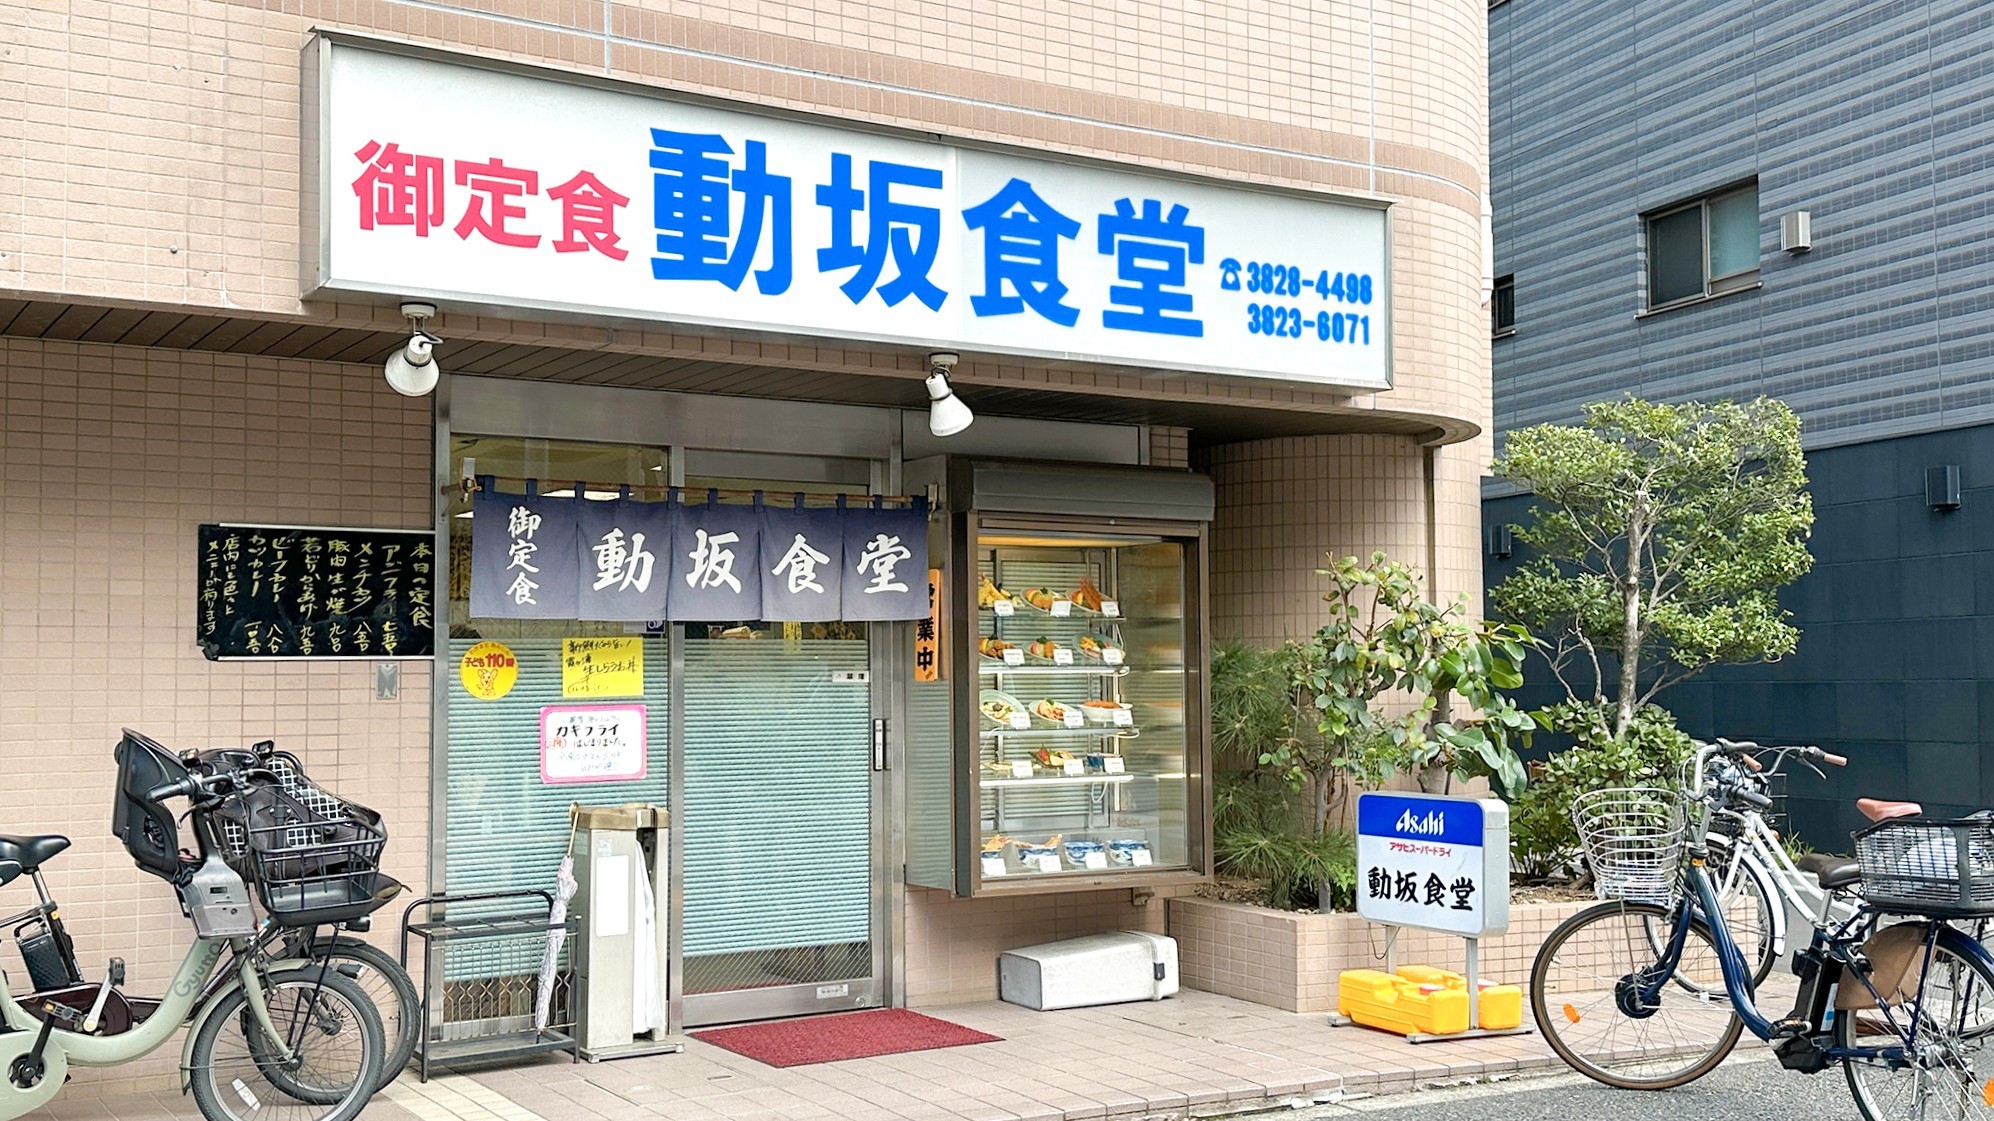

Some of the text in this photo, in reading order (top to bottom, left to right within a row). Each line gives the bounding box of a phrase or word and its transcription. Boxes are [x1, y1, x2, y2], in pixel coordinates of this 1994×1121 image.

[351, 128, 1205, 338] 御定食 動坂食堂
[1247, 261, 1373, 306] 3828-4498
[1247, 303, 1371, 346] 3823-6071
[247, 534, 267, 597] カツカレー
[268, 537, 295, 603] ビーフカレー
[347, 542, 373, 612] メンチカツ
[506, 505, 542, 605] 御定食
[591, 527, 913, 595] 動坂食堂
[1389, 841, 1452, 858] アサヒスーパードライ
[1395, 808, 1444, 836] Asahi
[1367, 866, 1476, 911] 動坂食堂
